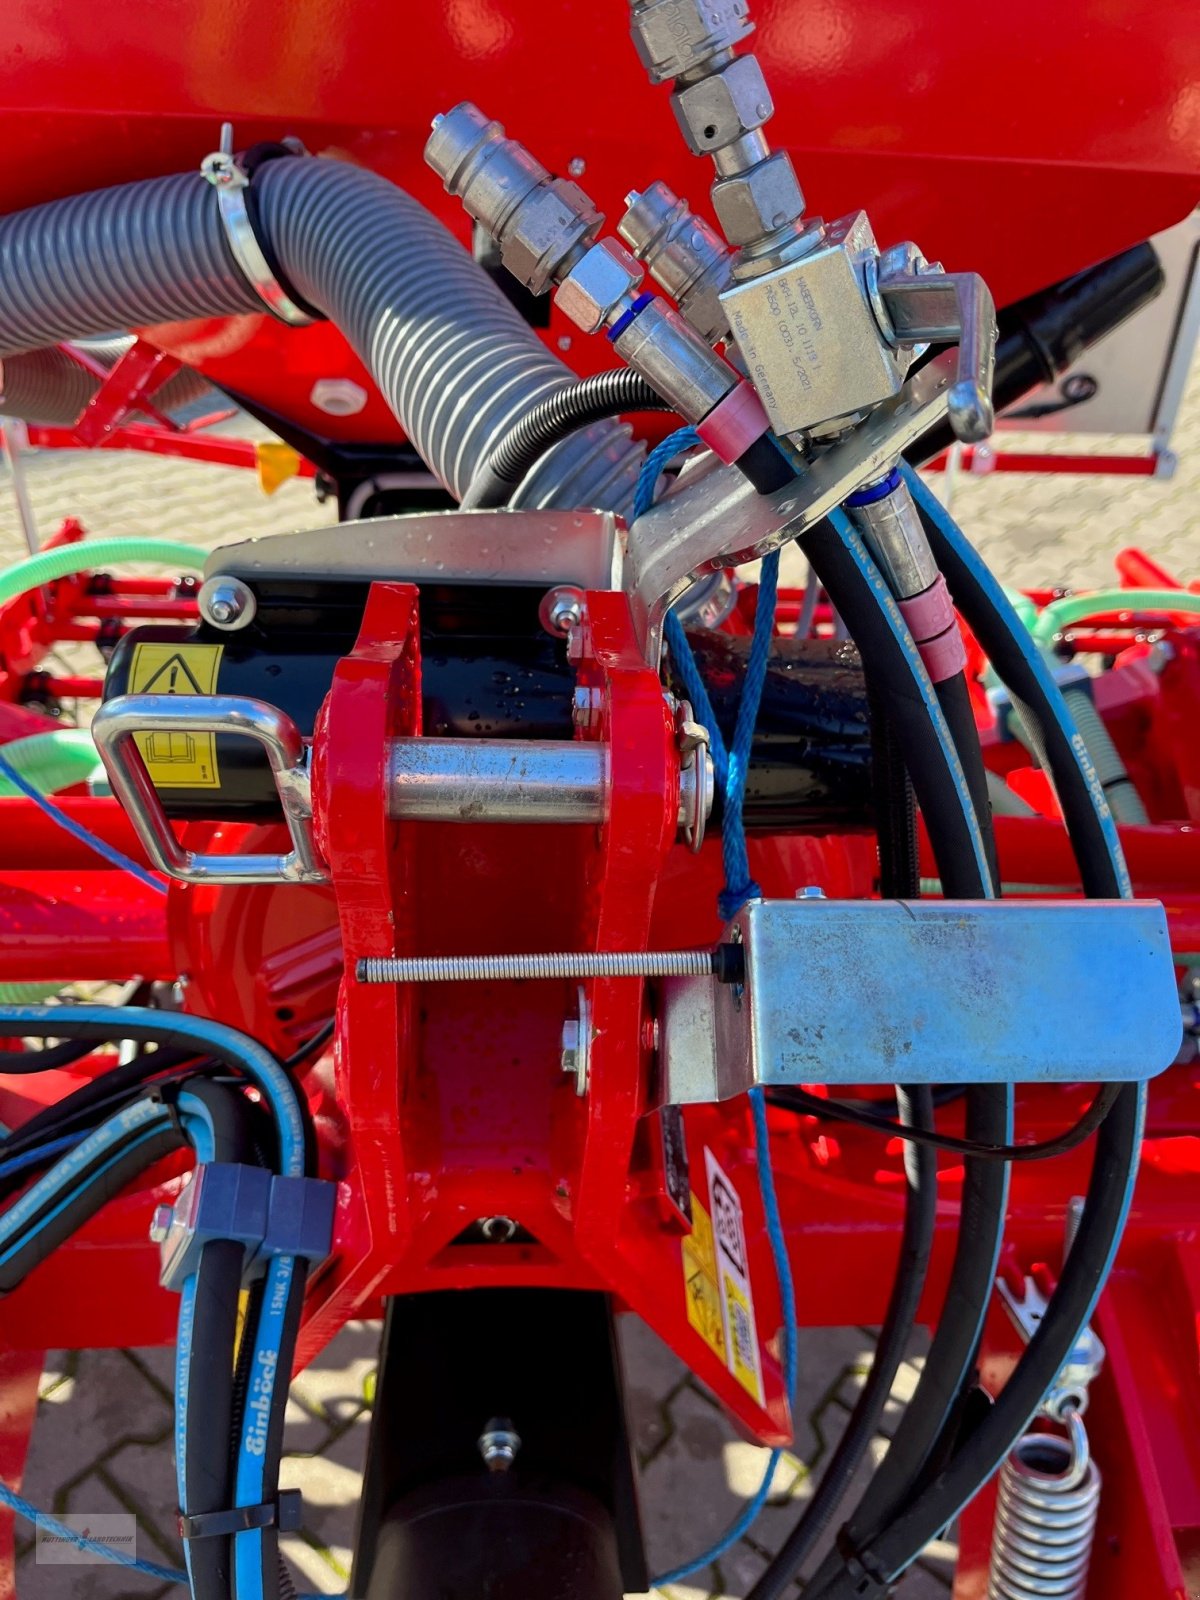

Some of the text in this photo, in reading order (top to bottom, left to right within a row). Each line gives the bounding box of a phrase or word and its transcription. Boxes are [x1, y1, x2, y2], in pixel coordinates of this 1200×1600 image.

[796, 276, 824, 332] HABERKORN
[732, 310, 778, 410] Made in Germany
[793, 357, 812, 392] 5/2021
[245, 1349, 278, 1456] Einböck
